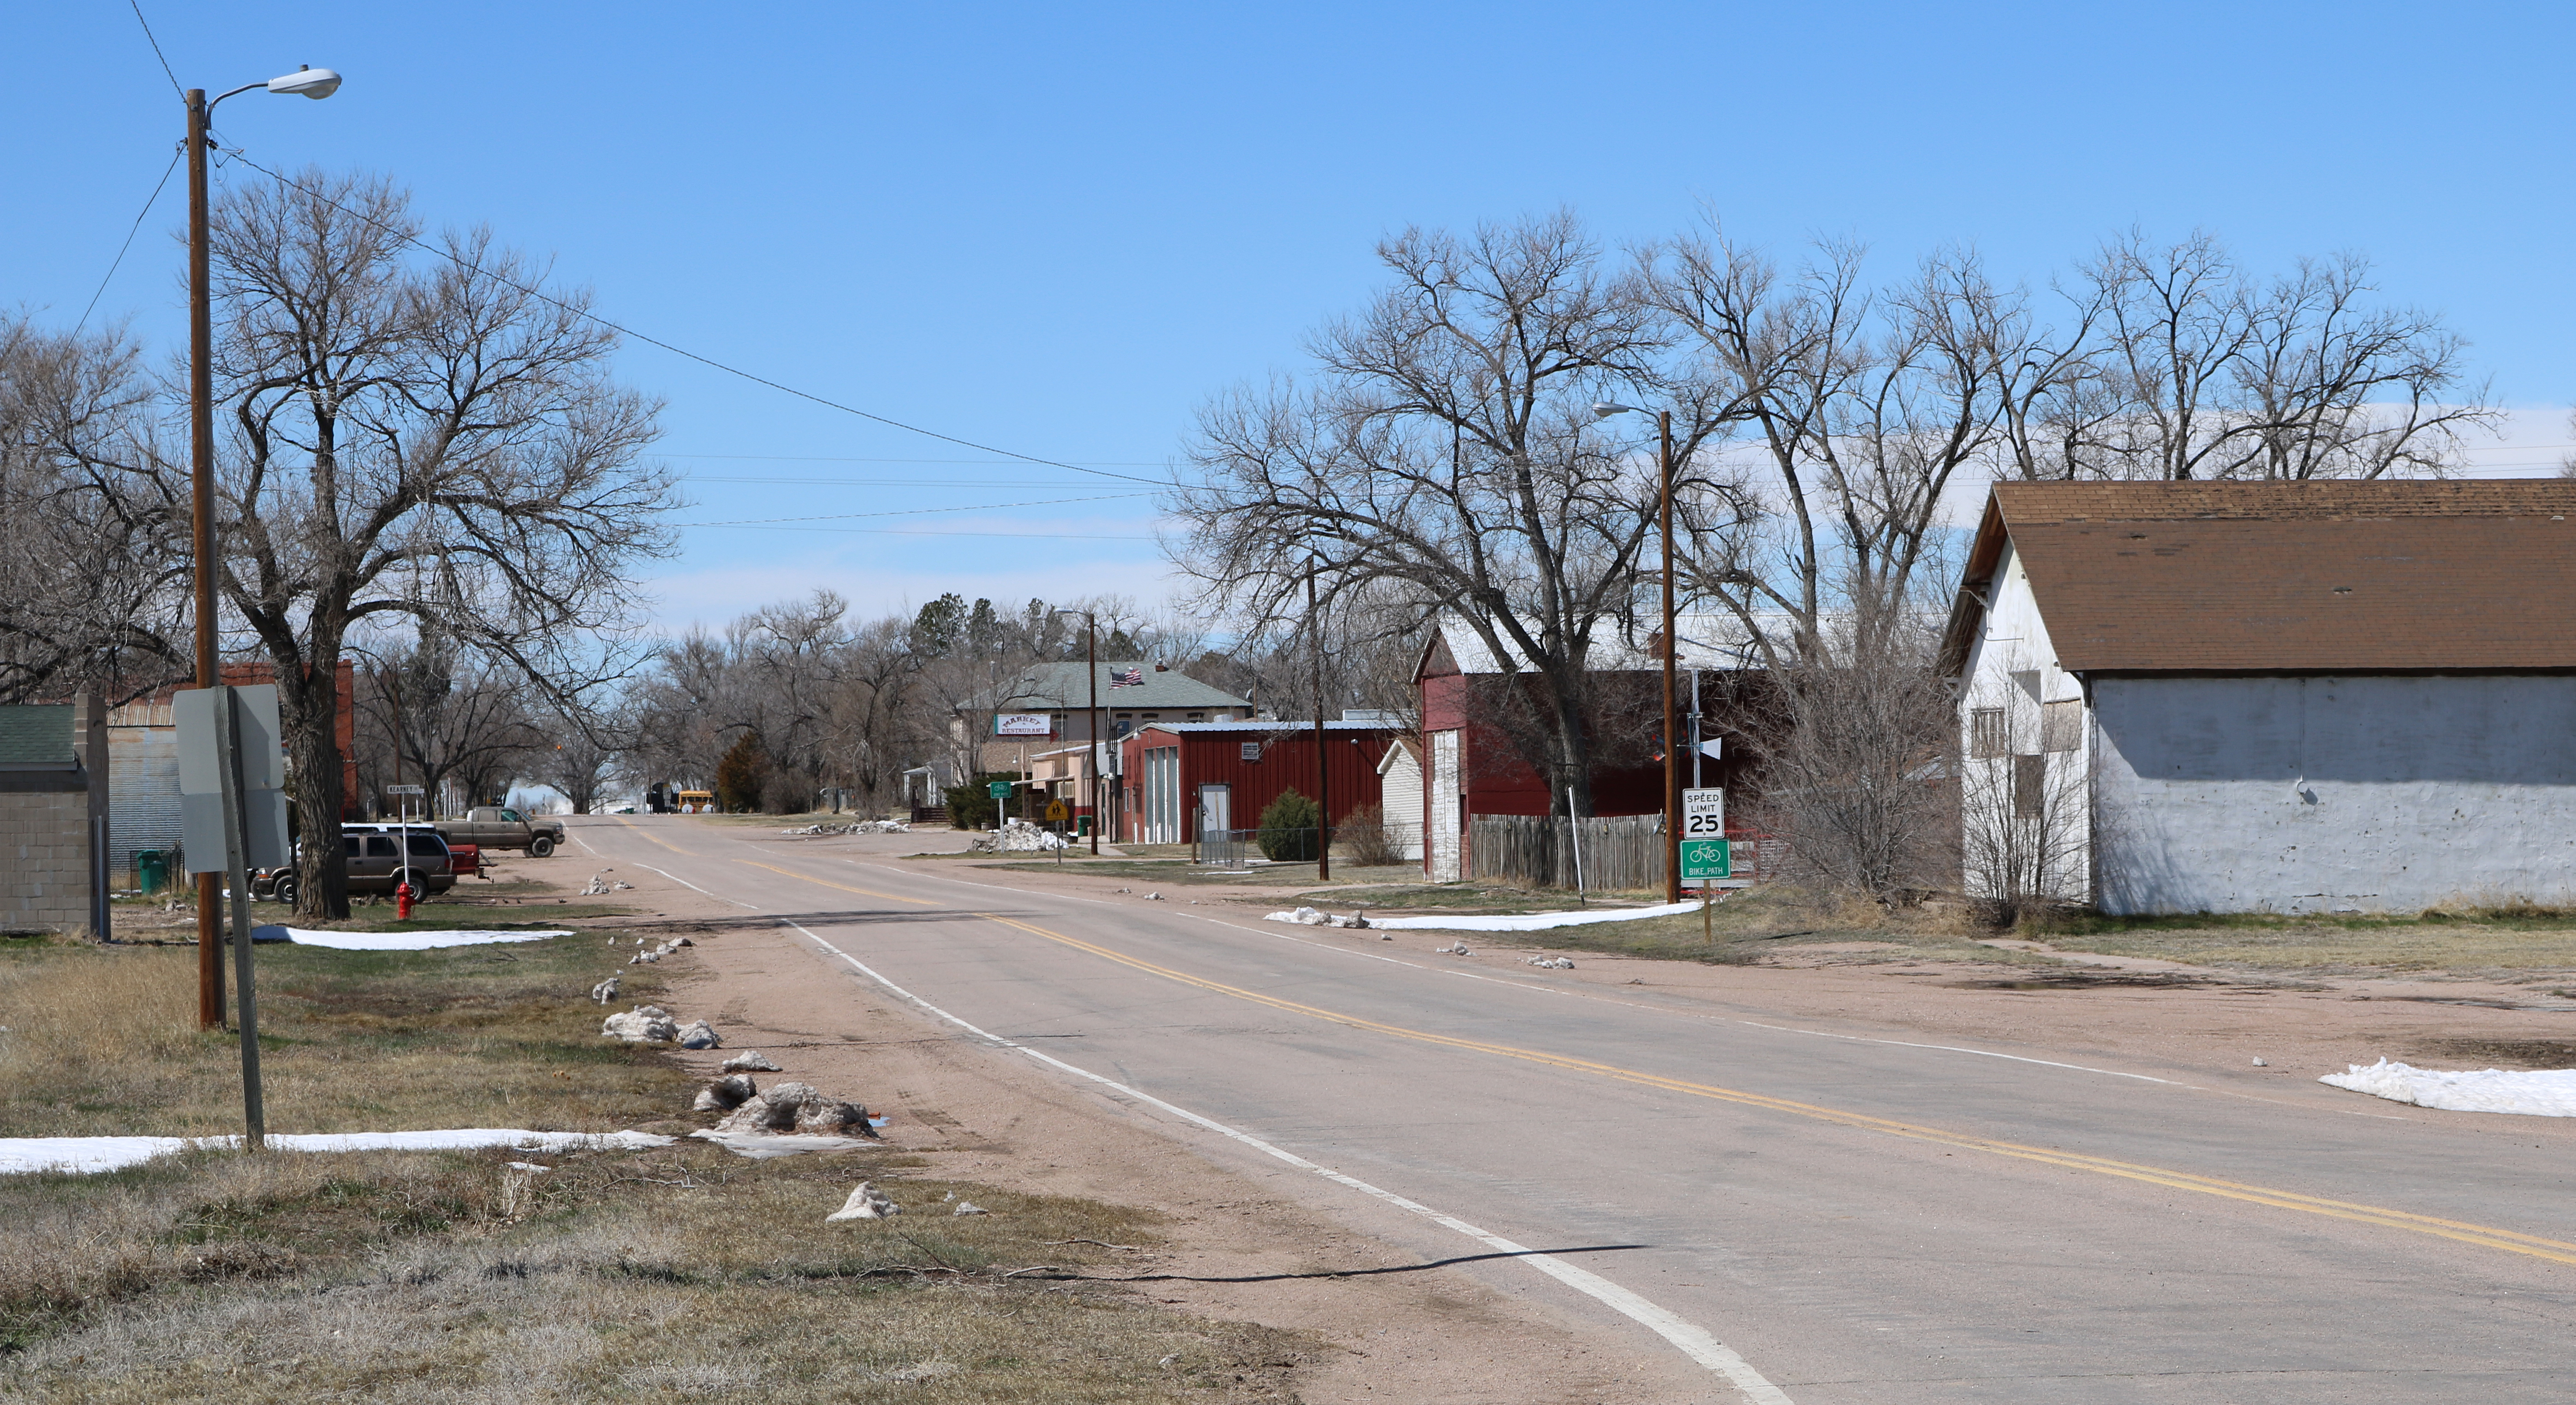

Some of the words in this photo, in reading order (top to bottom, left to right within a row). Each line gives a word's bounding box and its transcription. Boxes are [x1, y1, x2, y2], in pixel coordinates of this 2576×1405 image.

[1003, 716, 1041, 728] MARKET
[1687, 794, 1719, 803] SPEED
[1689, 815, 1718, 833] 25
